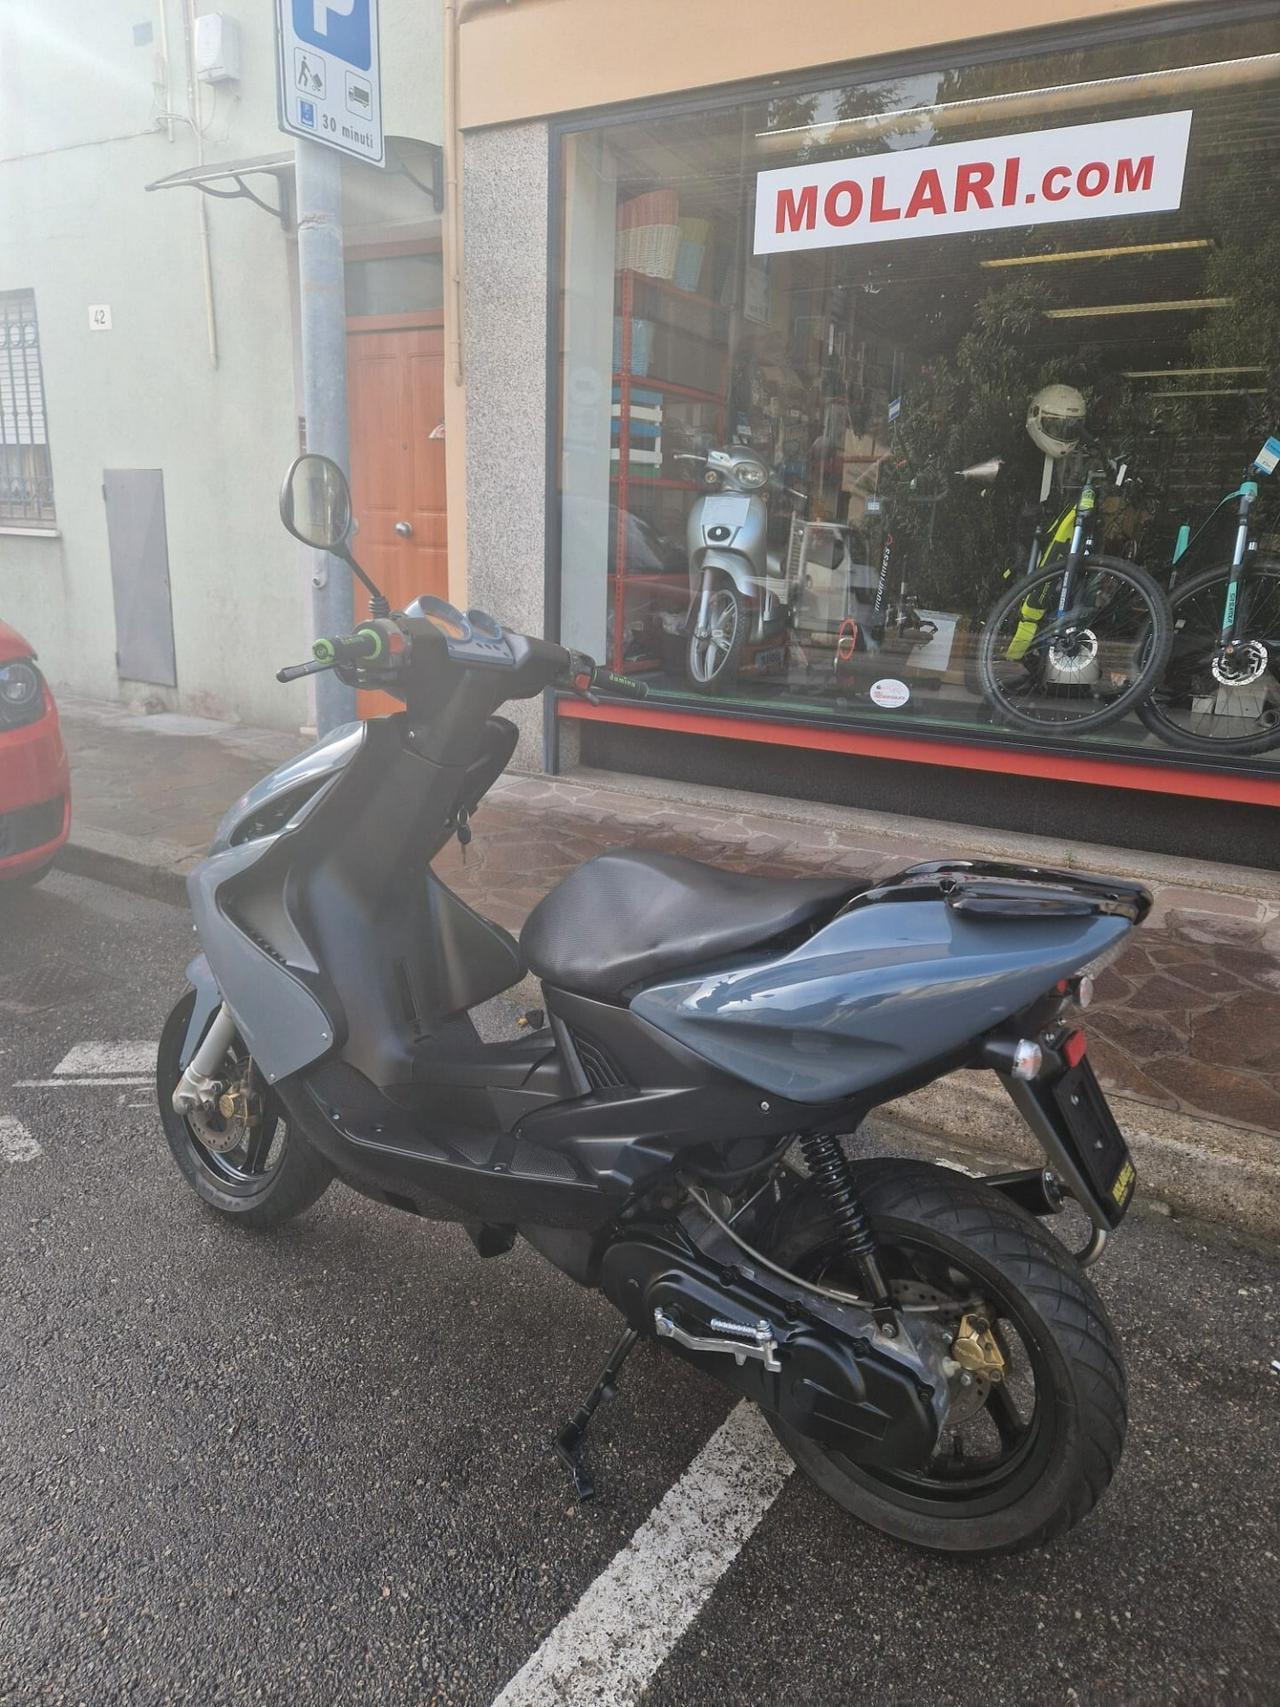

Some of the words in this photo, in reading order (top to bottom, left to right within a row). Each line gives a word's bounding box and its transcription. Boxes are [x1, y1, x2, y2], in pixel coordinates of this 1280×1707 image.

[322, 114, 337, 133] 30
[341, 125, 374, 149] minuti
[775, 155, 1155, 234] MOLARI.COM
[94, 309, 106, 325] 42
